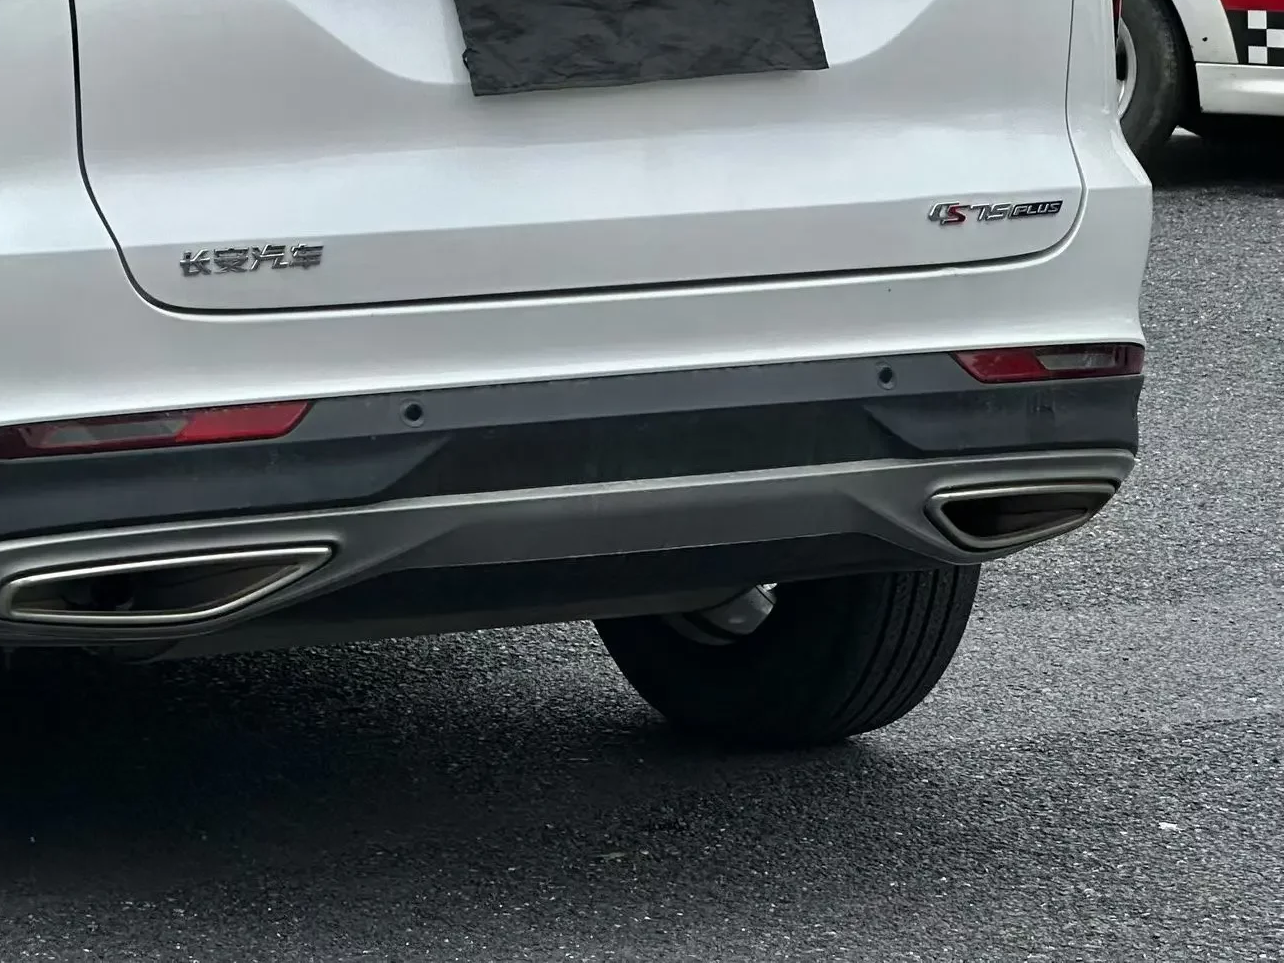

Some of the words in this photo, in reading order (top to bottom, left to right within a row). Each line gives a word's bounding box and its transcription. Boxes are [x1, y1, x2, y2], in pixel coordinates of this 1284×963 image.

[1012, 200, 1064, 218] PLUS
[179, 243, 325, 277] 长安汽车
